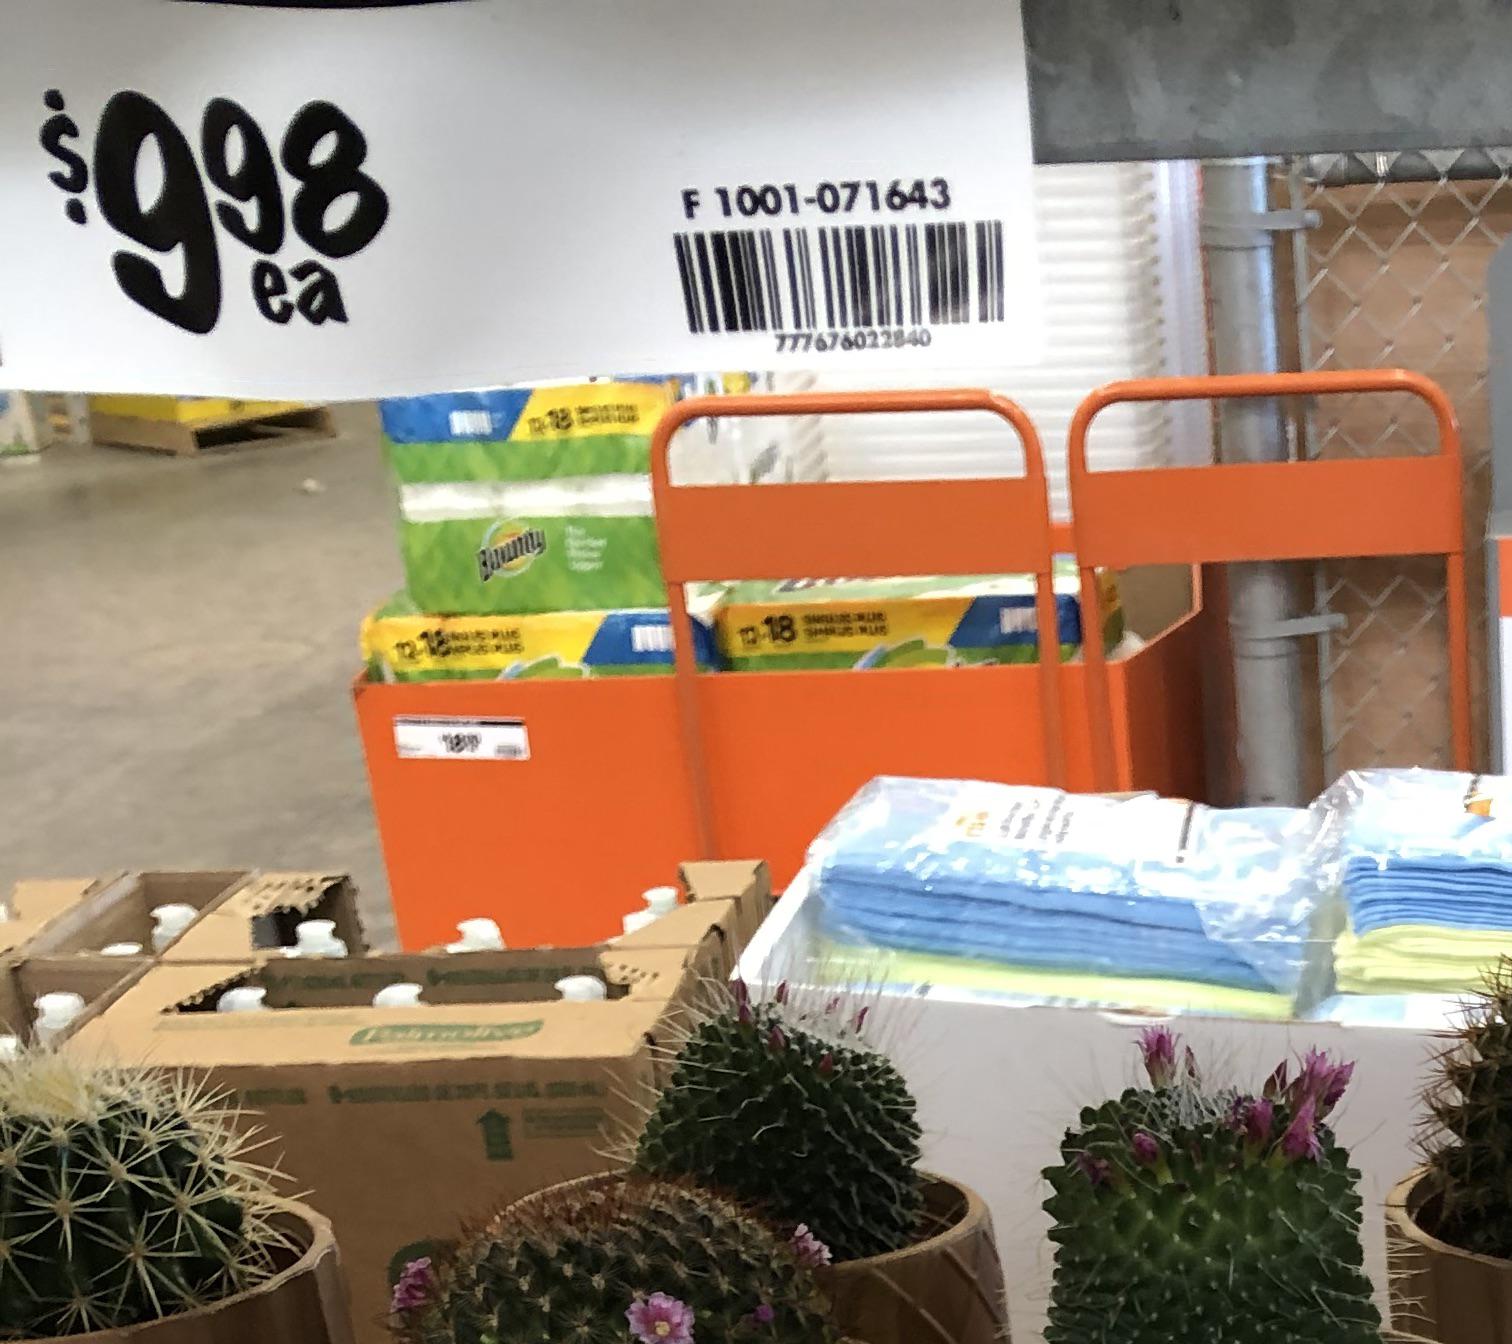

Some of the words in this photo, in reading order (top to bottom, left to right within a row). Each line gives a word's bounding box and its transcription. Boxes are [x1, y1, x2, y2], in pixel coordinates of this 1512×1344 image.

[681, 187, 701, 219] F
[714, 176, 951, 217] 1001-071643
[252, 258, 349, 325] ea
